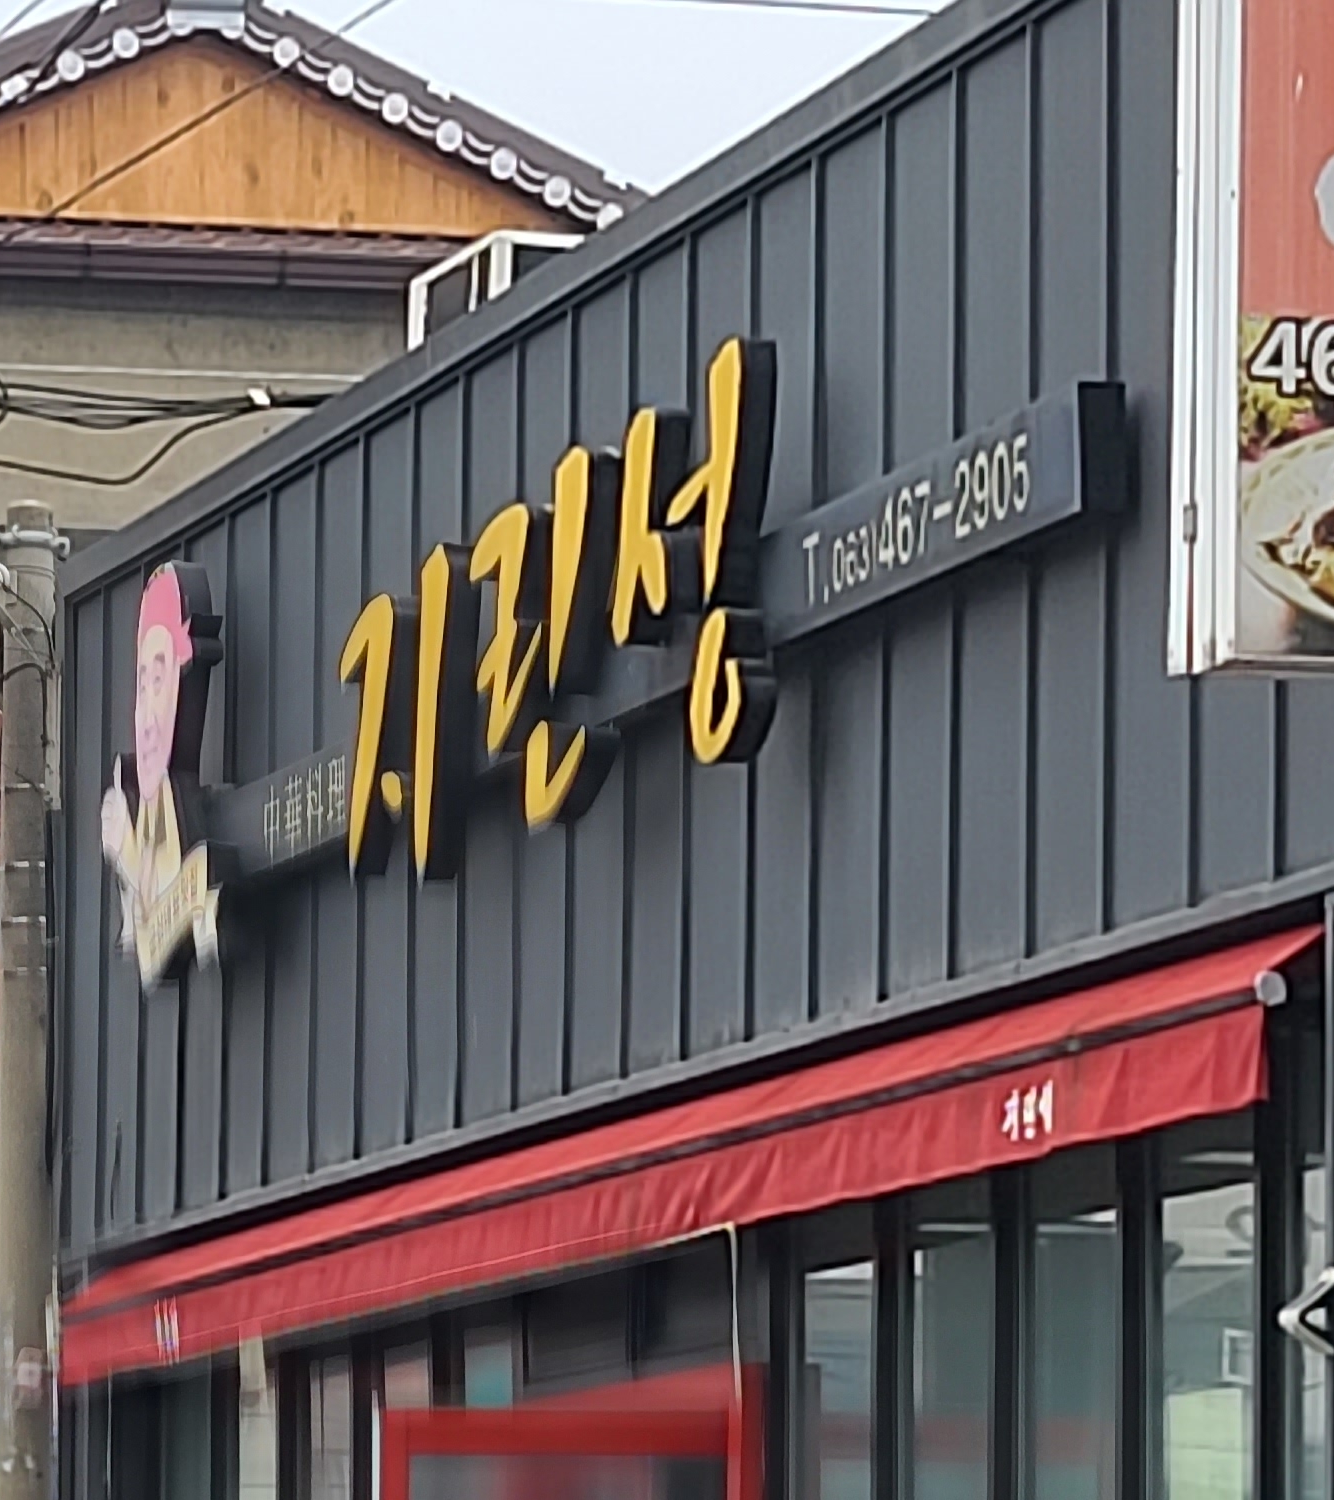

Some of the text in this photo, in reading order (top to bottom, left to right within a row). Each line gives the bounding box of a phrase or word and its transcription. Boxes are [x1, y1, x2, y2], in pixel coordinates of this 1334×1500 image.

[339, 336, 745, 888] 지린성
[262, 753, 348, 868] 中華料理
